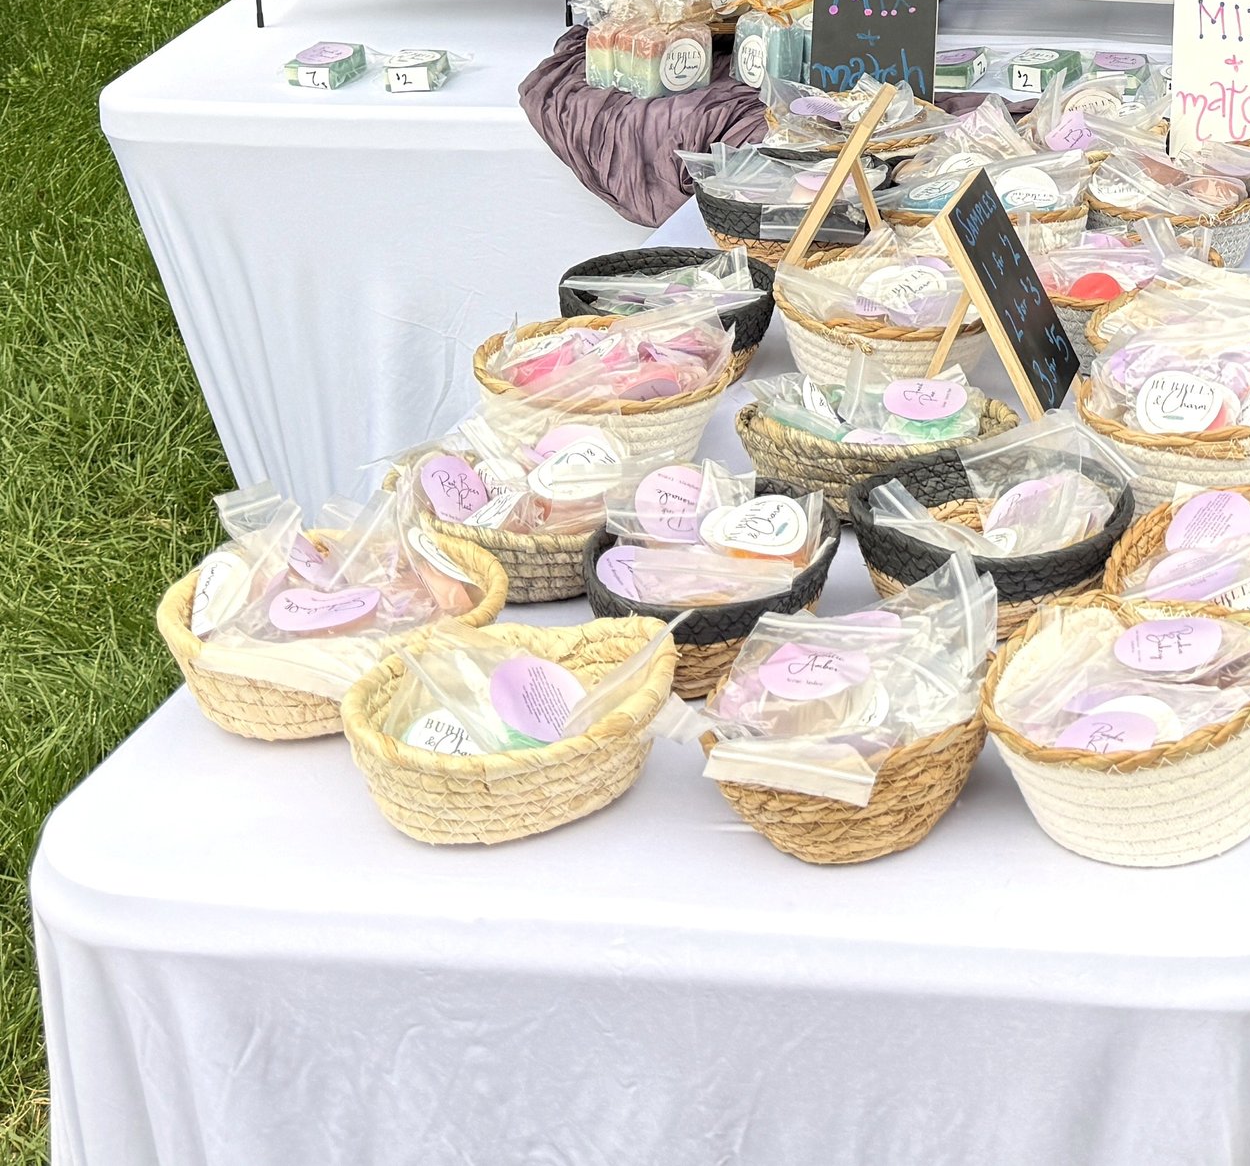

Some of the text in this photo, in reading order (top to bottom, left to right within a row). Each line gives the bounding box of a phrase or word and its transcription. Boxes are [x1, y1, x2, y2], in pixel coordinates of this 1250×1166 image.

[1017, 70, 1033, 87] $2
[954, 189, 998, 247] SAMPLES
[981, 261, 998, 290] 1
[1031, 358, 1056, 407] 3
[1151, 378, 1216, 395] BUBBLES
[788, 653, 839, 675] Amber
[424, 717, 472, 742] BUBBL
[424, 735, 436, 747] &
